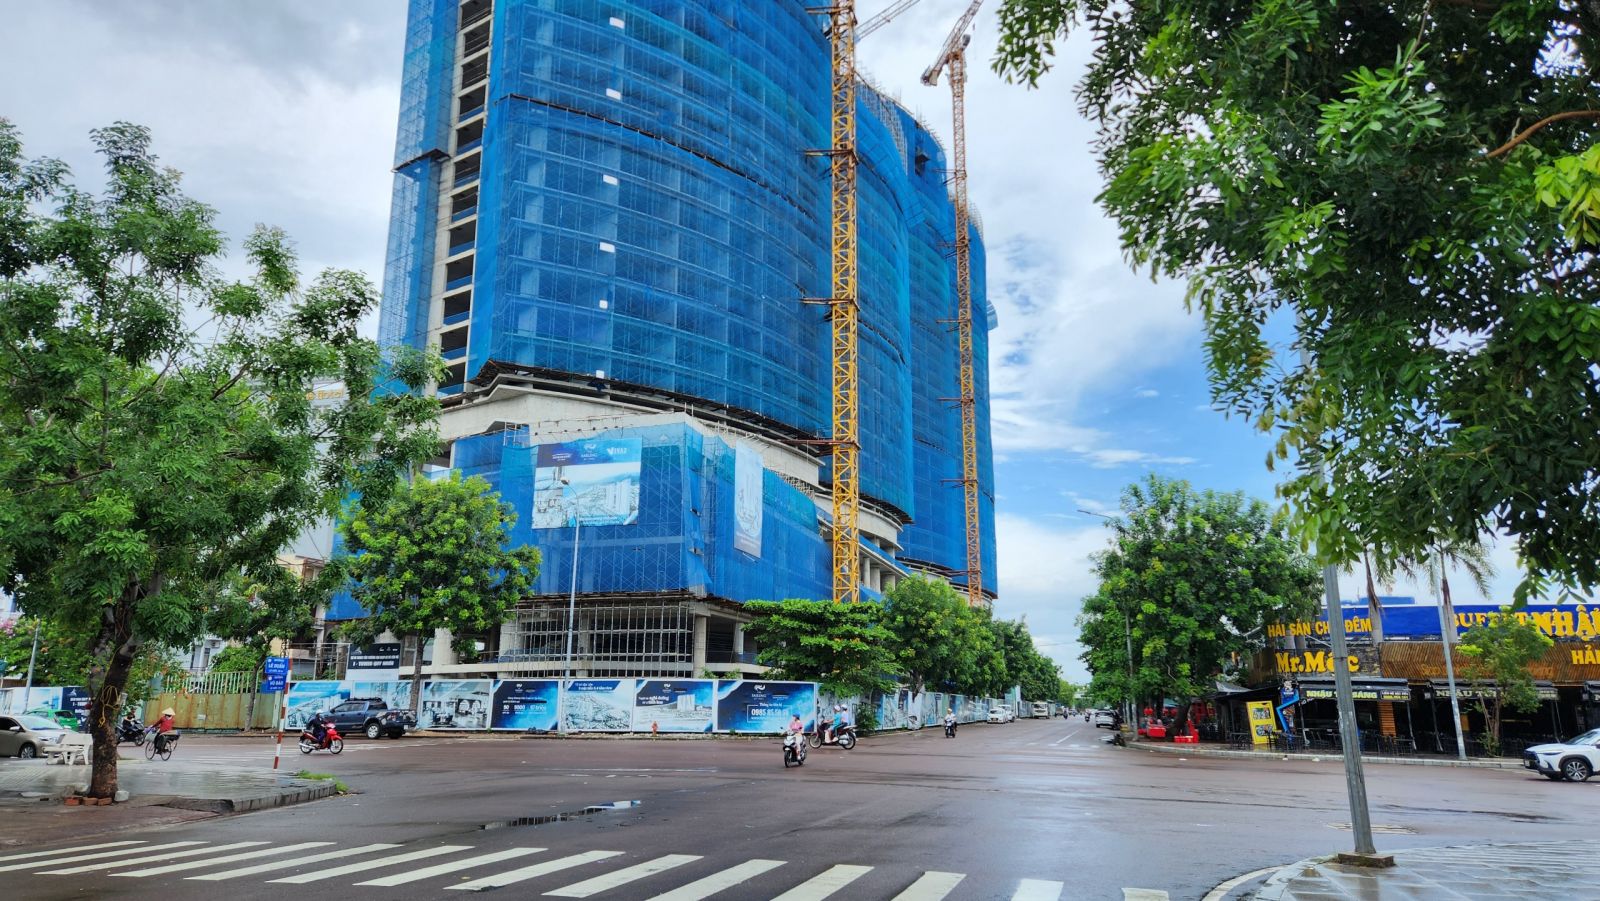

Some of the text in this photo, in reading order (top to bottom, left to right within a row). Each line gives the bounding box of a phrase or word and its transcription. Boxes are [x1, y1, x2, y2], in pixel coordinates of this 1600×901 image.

[1267, 620, 1286, 637] HẢI
[1289, 619, 1311, 635] SẢN
[1344, 616, 1372, 632] ĐÊM
